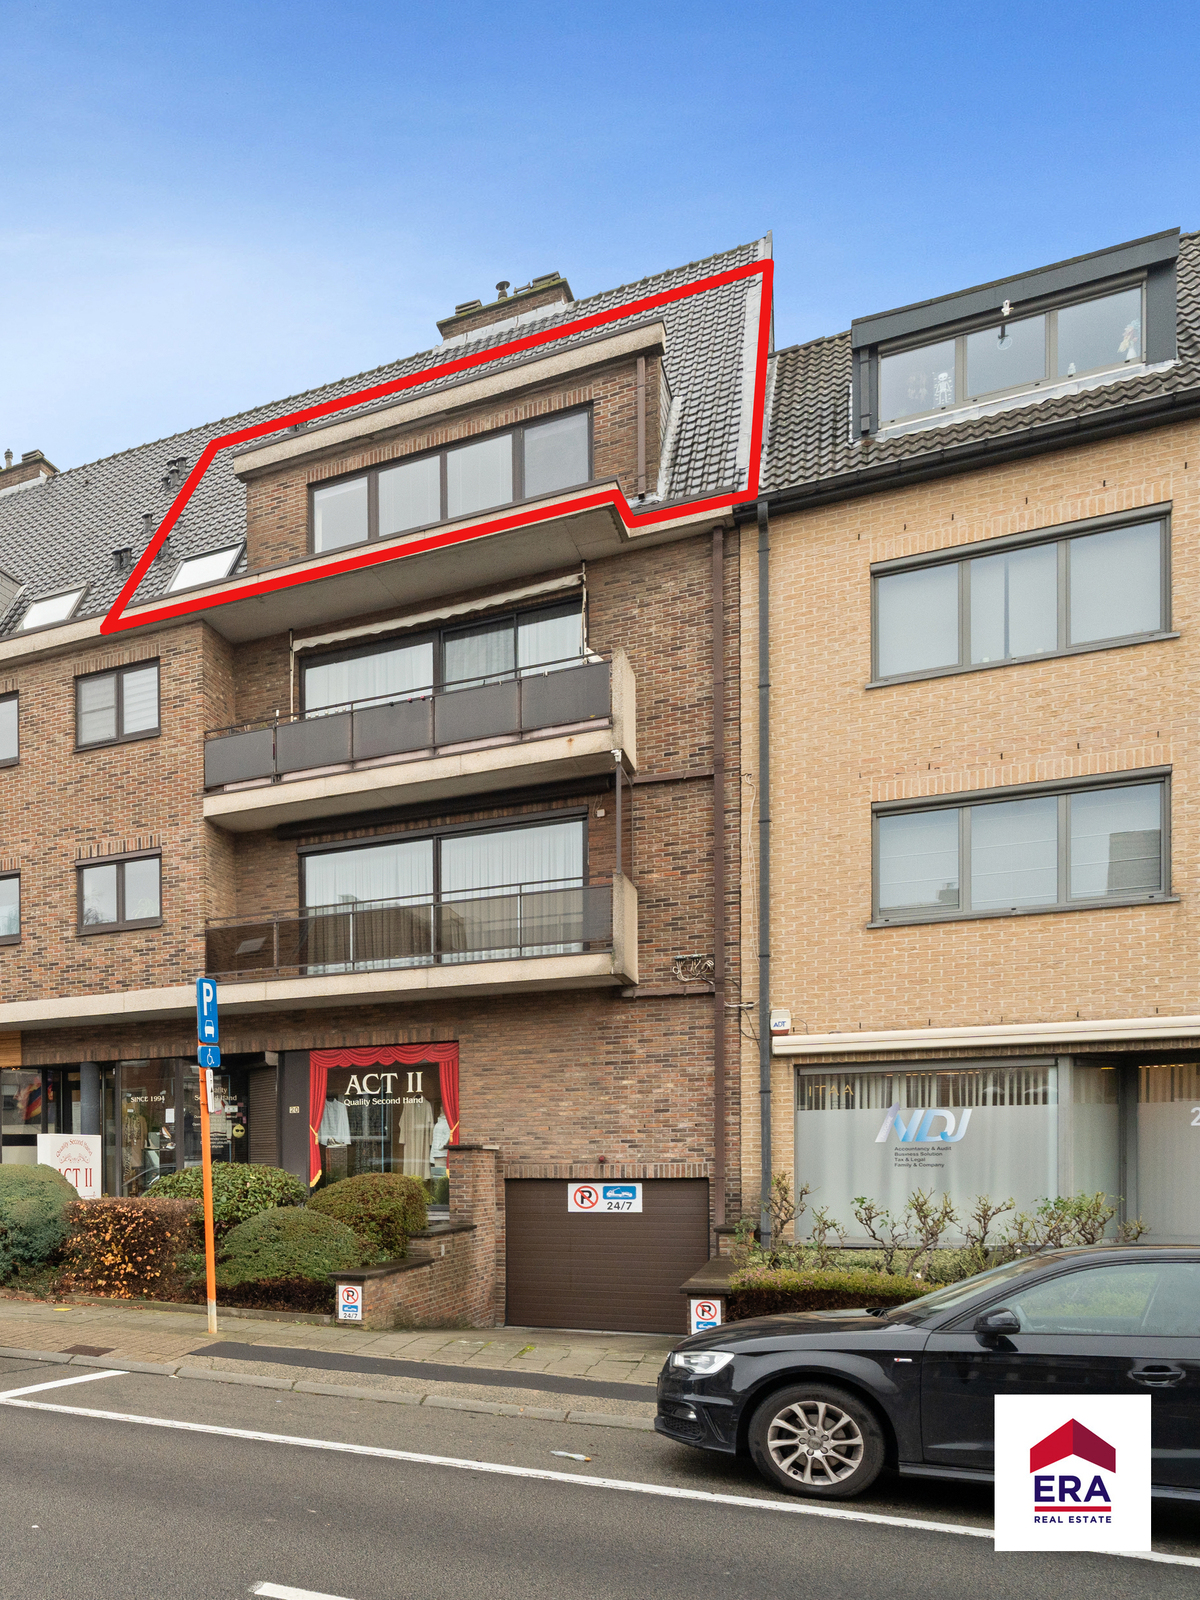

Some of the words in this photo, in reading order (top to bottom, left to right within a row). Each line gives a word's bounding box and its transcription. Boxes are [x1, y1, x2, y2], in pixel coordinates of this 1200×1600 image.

[344, 1072, 399, 1096] ACT
[406, 1071, 424, 1093] II
[808, 1085, 854, 1097] ITAA
[344, 1098, 371, 1107] Quality
[371, 1097, 401, 1106] Second
[402, 1096, 424, 1104] Hand
[875, 1101, 973, 1143] NDJ
[607, 1201, 632, 1210] 24/7
